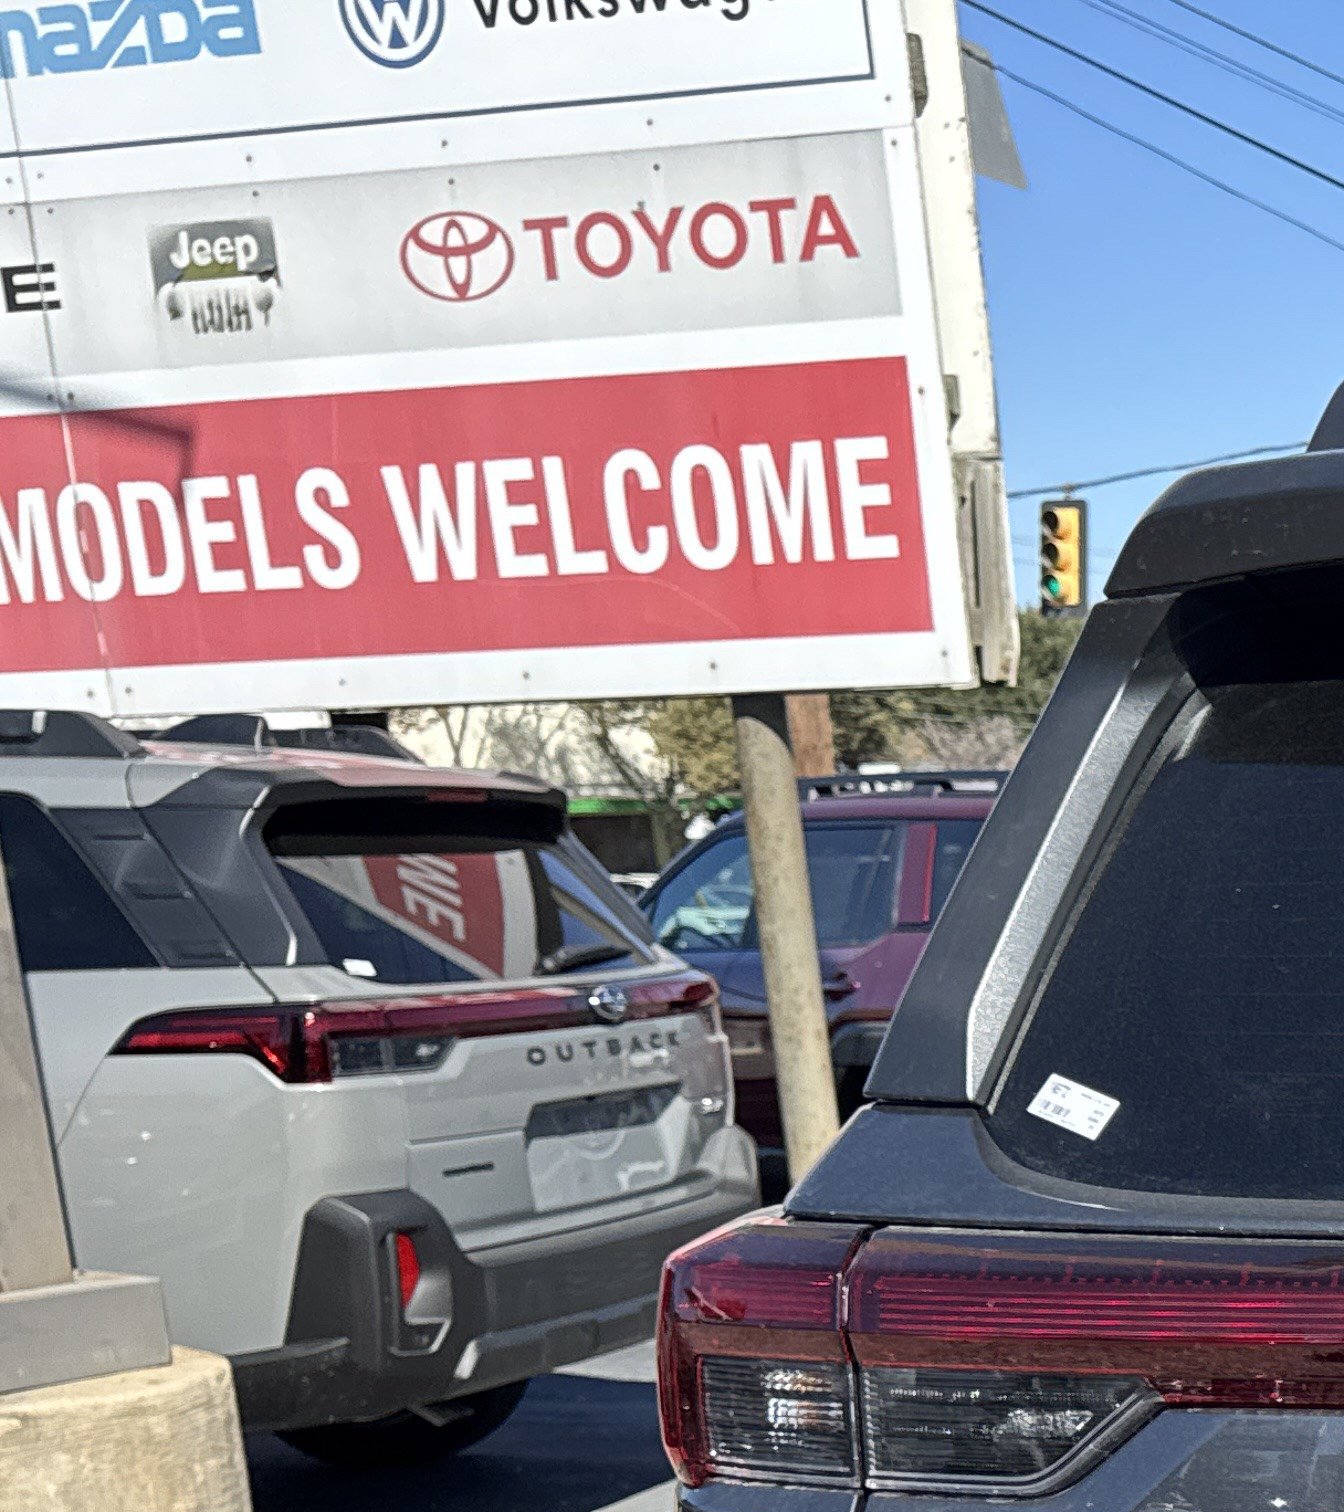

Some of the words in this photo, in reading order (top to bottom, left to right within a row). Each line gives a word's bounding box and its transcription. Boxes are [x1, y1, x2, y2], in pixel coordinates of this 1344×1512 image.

[169, 230, 259, 272] Jeep
[522, 195, 859, 282] TOYOTA
[0, 467, 361, 605] MODELS
[381, 436, 899, 583] WELCOME
[526, 1030, 680, 1066] OUTBACK
